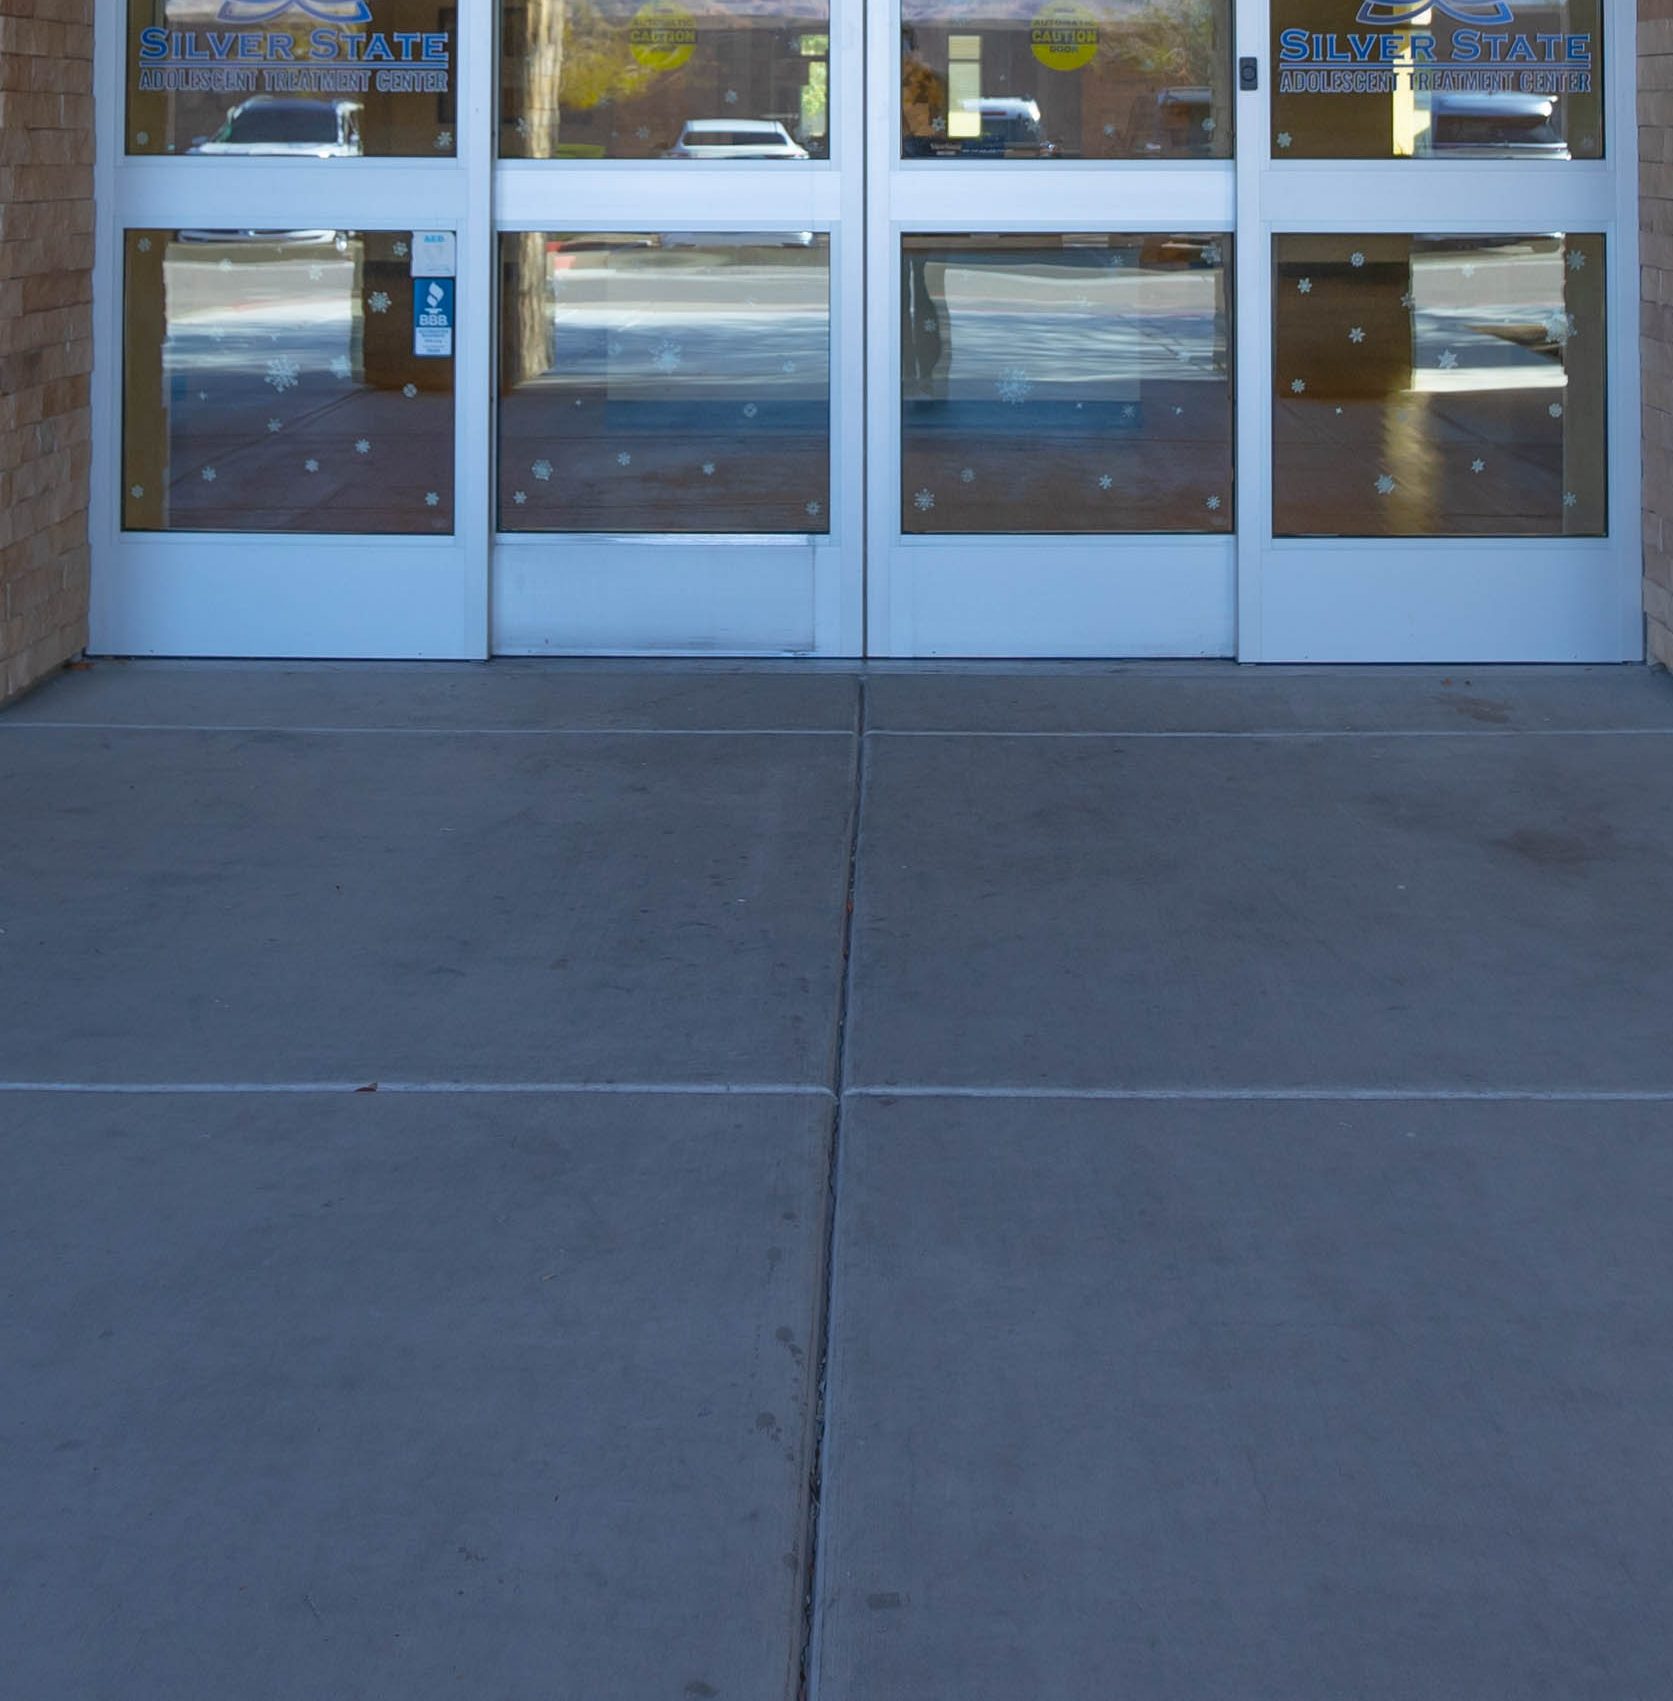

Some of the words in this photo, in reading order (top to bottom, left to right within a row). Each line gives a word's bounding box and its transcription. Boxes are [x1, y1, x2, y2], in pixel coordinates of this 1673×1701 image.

[1032, 18, 1095, 27] AUTOMATIC
[631, 29, 696, 43] CAUTION
[1031, 29, 1097, 43] CAUTION
[139, 26, 295, 60] SILVER
[310, 27, 449, 61] STATE
[1279, 28, 1437, 61] SILVER
[1451, 28, 1591, 61] STATE
[139, 68, 258, 91] ADOLESCENT
[263, 69, 372, 92] TREATMENT
[375, 69, 449, 92] CENTER
[1279, 70, 1398, 94] ADOLESCENT
[1407, 70, 1515, 94] TREATMENT
[1519, 70, 1592, 94] CENTER
[423, 234, 446, 243] AED
[419, 314, 448, 326] BBB
